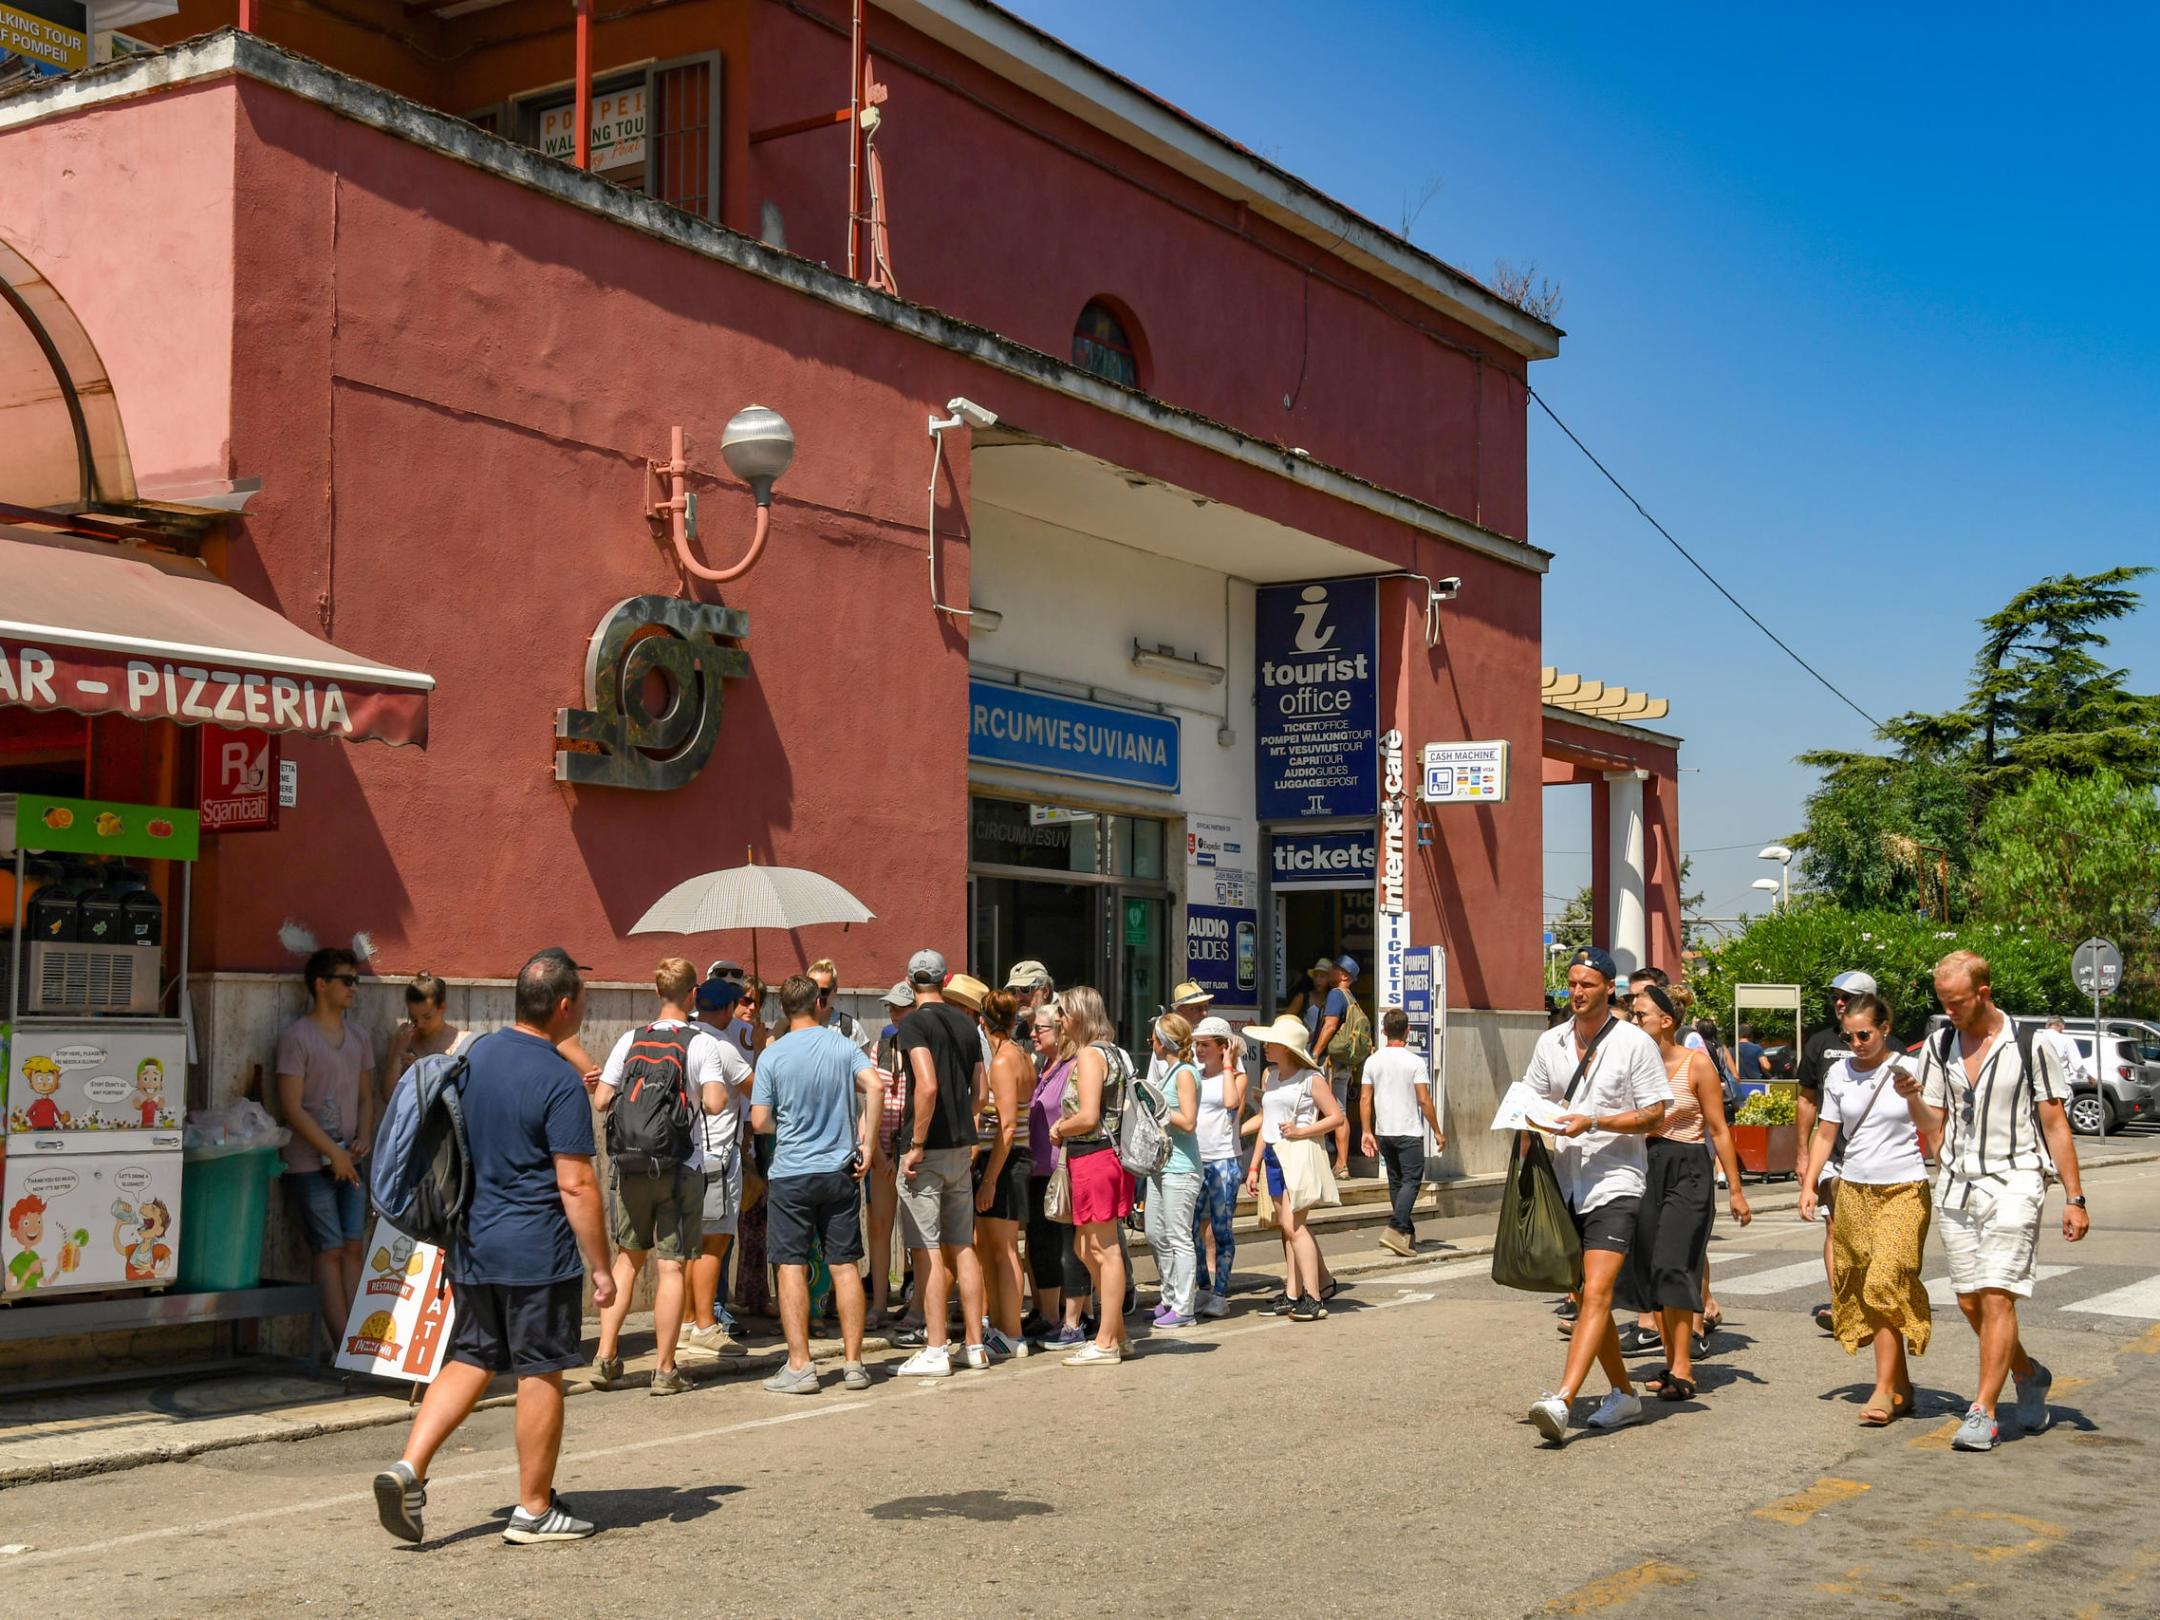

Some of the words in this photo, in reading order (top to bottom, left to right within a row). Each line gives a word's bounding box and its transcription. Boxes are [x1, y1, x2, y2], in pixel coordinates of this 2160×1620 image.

[12, 32, 68, 64] POMPEII
[43, 26, 81, 51] TOUR
[545, 92, 643, 135] POPEI
[545, 125, 611, 155] WALNG
[1262, 653, 1368, 687] tourist
[126, 660, 354, 733] PIZZERIA
[1279, 686, 1351, 714] office
[1261, 735, 1299, 746] POMPEI
[1270, 747, 1286, 757] MT.
[1430, 752, 1452, 761] CASH
[1454, 750, 1496, 760] MACHINE
[203, 795, 267, 828] Sgambati
[1273, 843, 1376, 871] tickets
[1380, 799, 1403, 913] internet
[1188, 917, 1229, 939] AUDIO
[1187, 939, 1229, 961] GUIDES
[1387, 914, 1402, 1005] TICKETS
[1404, 974, 1429, 991] TICKETS
